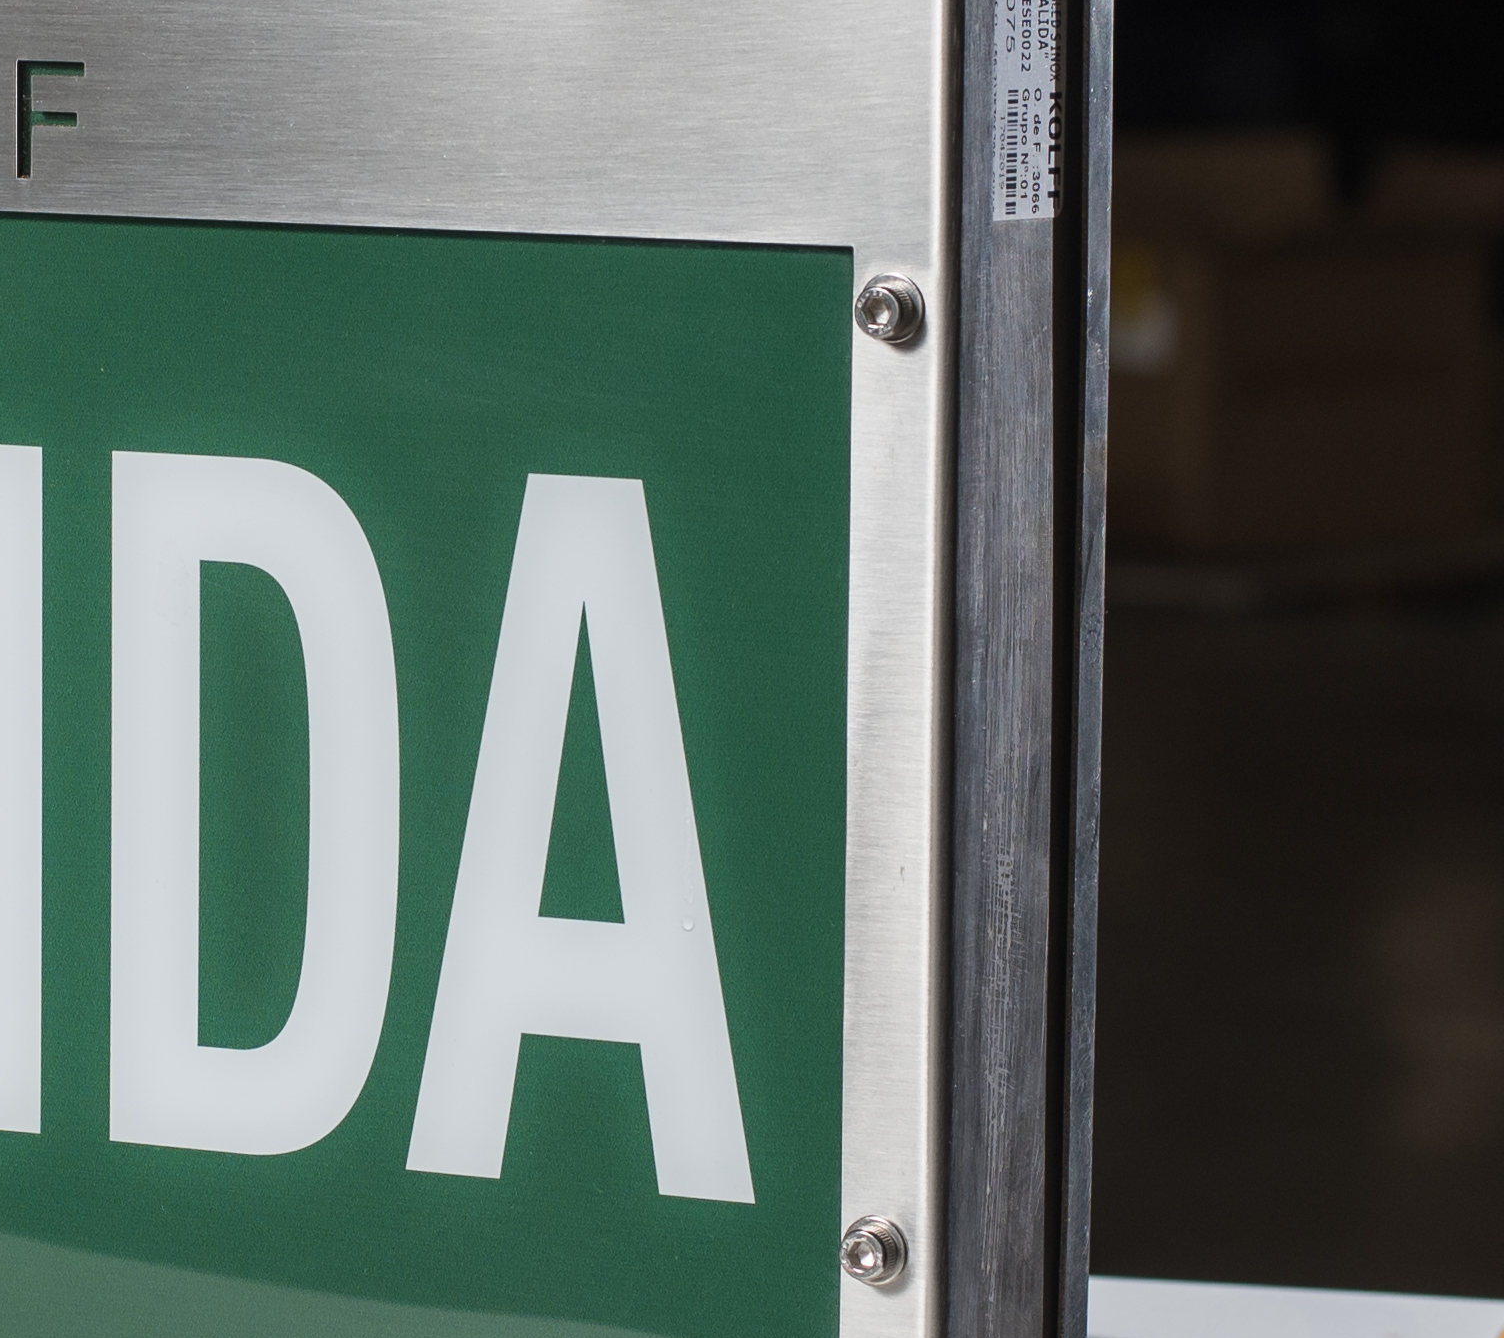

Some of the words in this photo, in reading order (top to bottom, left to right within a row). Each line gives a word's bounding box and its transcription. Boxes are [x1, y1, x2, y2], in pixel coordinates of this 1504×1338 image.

[1020, 88, 1030, 145] Grupo
[1033, 114, 1042, 136] de
[1047, 92, 1063, 209] KOLFF
